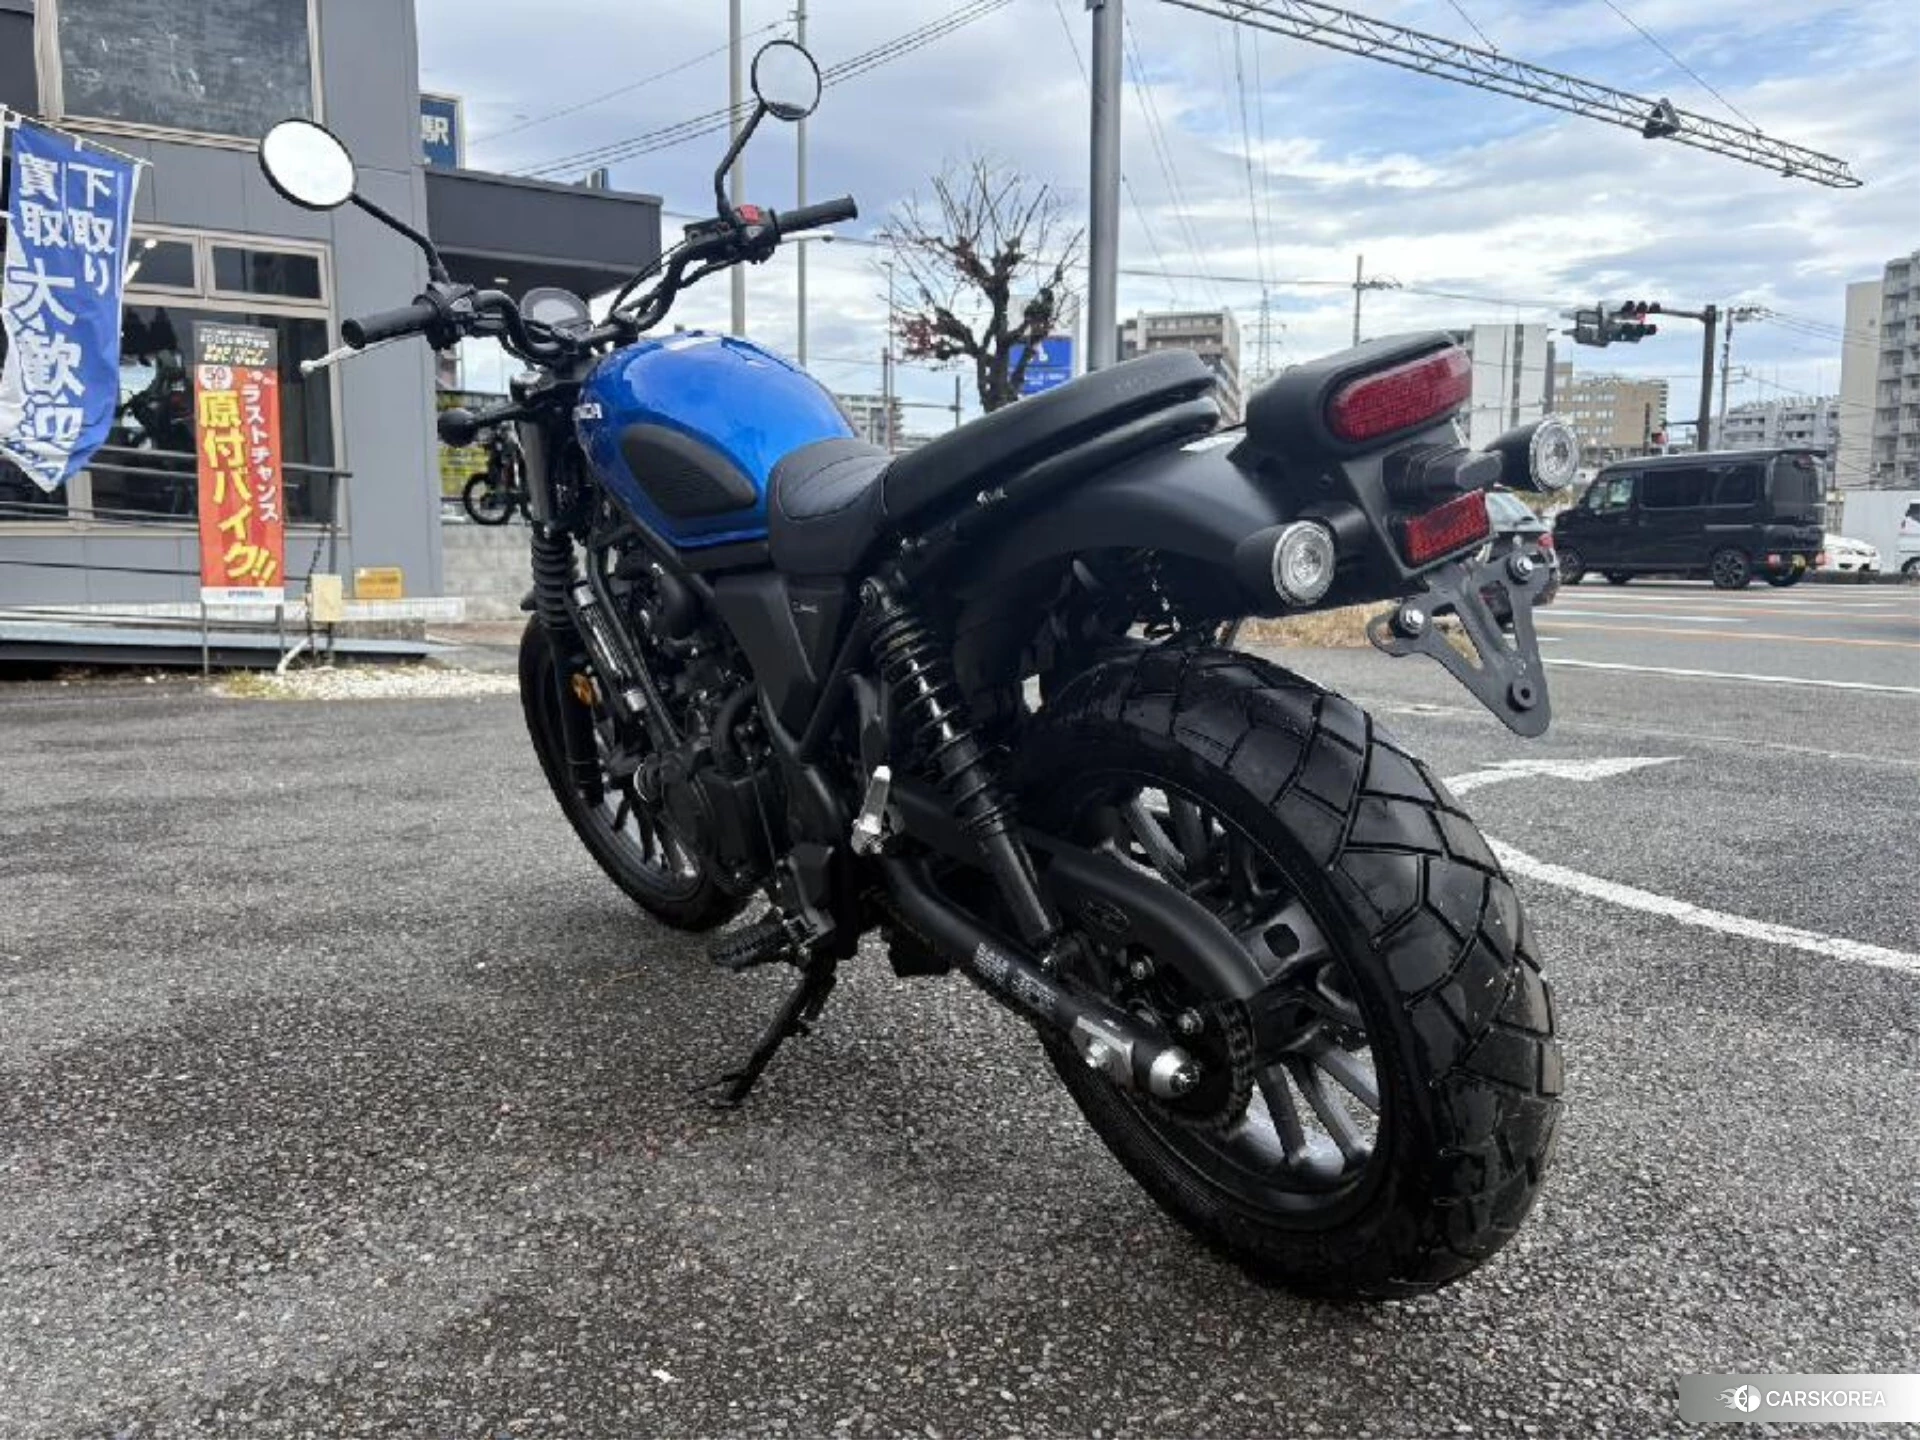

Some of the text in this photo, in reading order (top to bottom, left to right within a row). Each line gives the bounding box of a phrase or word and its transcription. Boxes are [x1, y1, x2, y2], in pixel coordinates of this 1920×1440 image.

[18, 152, 67, 248] 買取
[68, 162, 117, 296] 下取り
[241, 384, 279, 522] ラストチャンス
